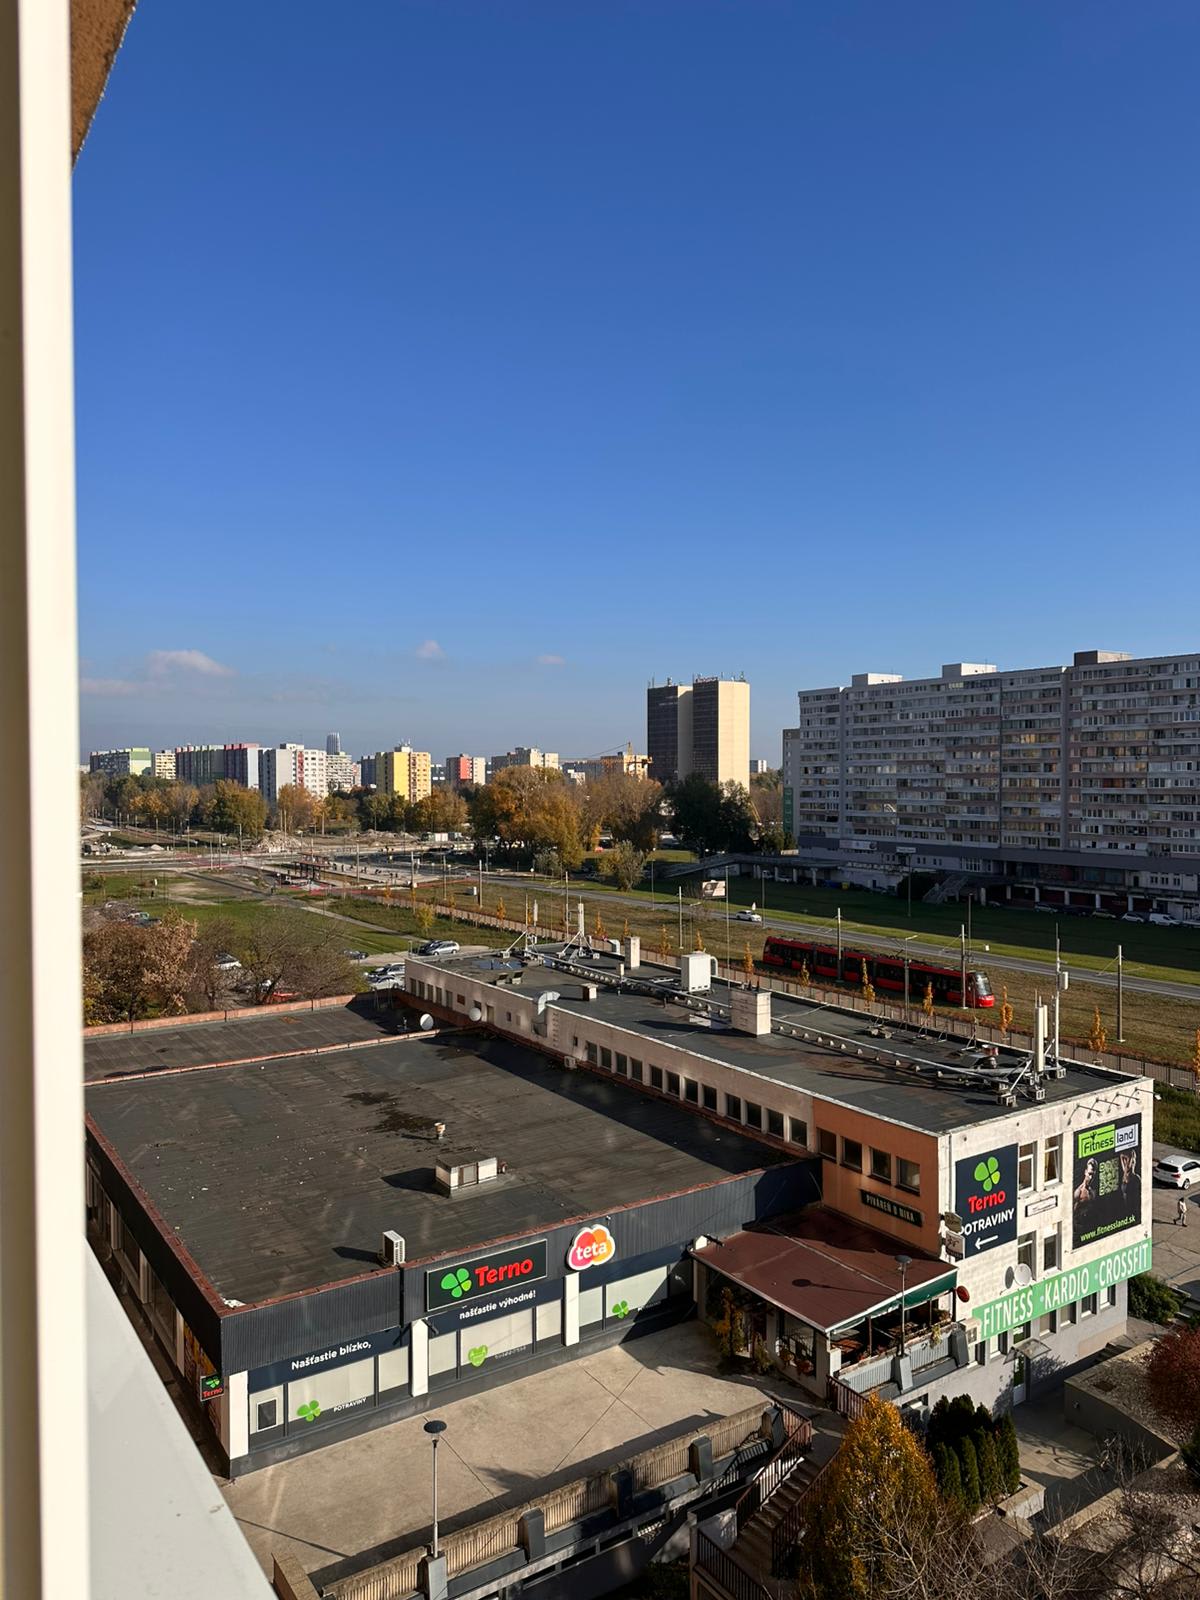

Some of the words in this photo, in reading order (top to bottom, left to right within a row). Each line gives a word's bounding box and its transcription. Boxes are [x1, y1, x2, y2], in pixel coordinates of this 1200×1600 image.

[1083, 1137, 1114, 1154] Fitness
[1117, 1129, 1134, 1143] land
[968, 1190, 1006, 1214] Terno
[1080, 1214, 1136, 1242] www.fitnessland.sk
[576, 1240, 608, 1260] teta
[474, 1258, 533, 1287] Terno
[983, 1290, 1034, 1337] FITNESS
[1044, 1267, 1090, 1310] KARDIO
[1099, 1243, 1149, 1287] CROSSFIT
[459, 1302, 497, 1320] našťastie
[499, 1289, 537, 1308] výhodné!
[291, 1349, 337, 1370] Našťastie
[339, 1341, 372, 1356] blízko,
[202, 1387, 223, 1398] Terno
[333, 1397, 367, 1413] POTRAVINY
